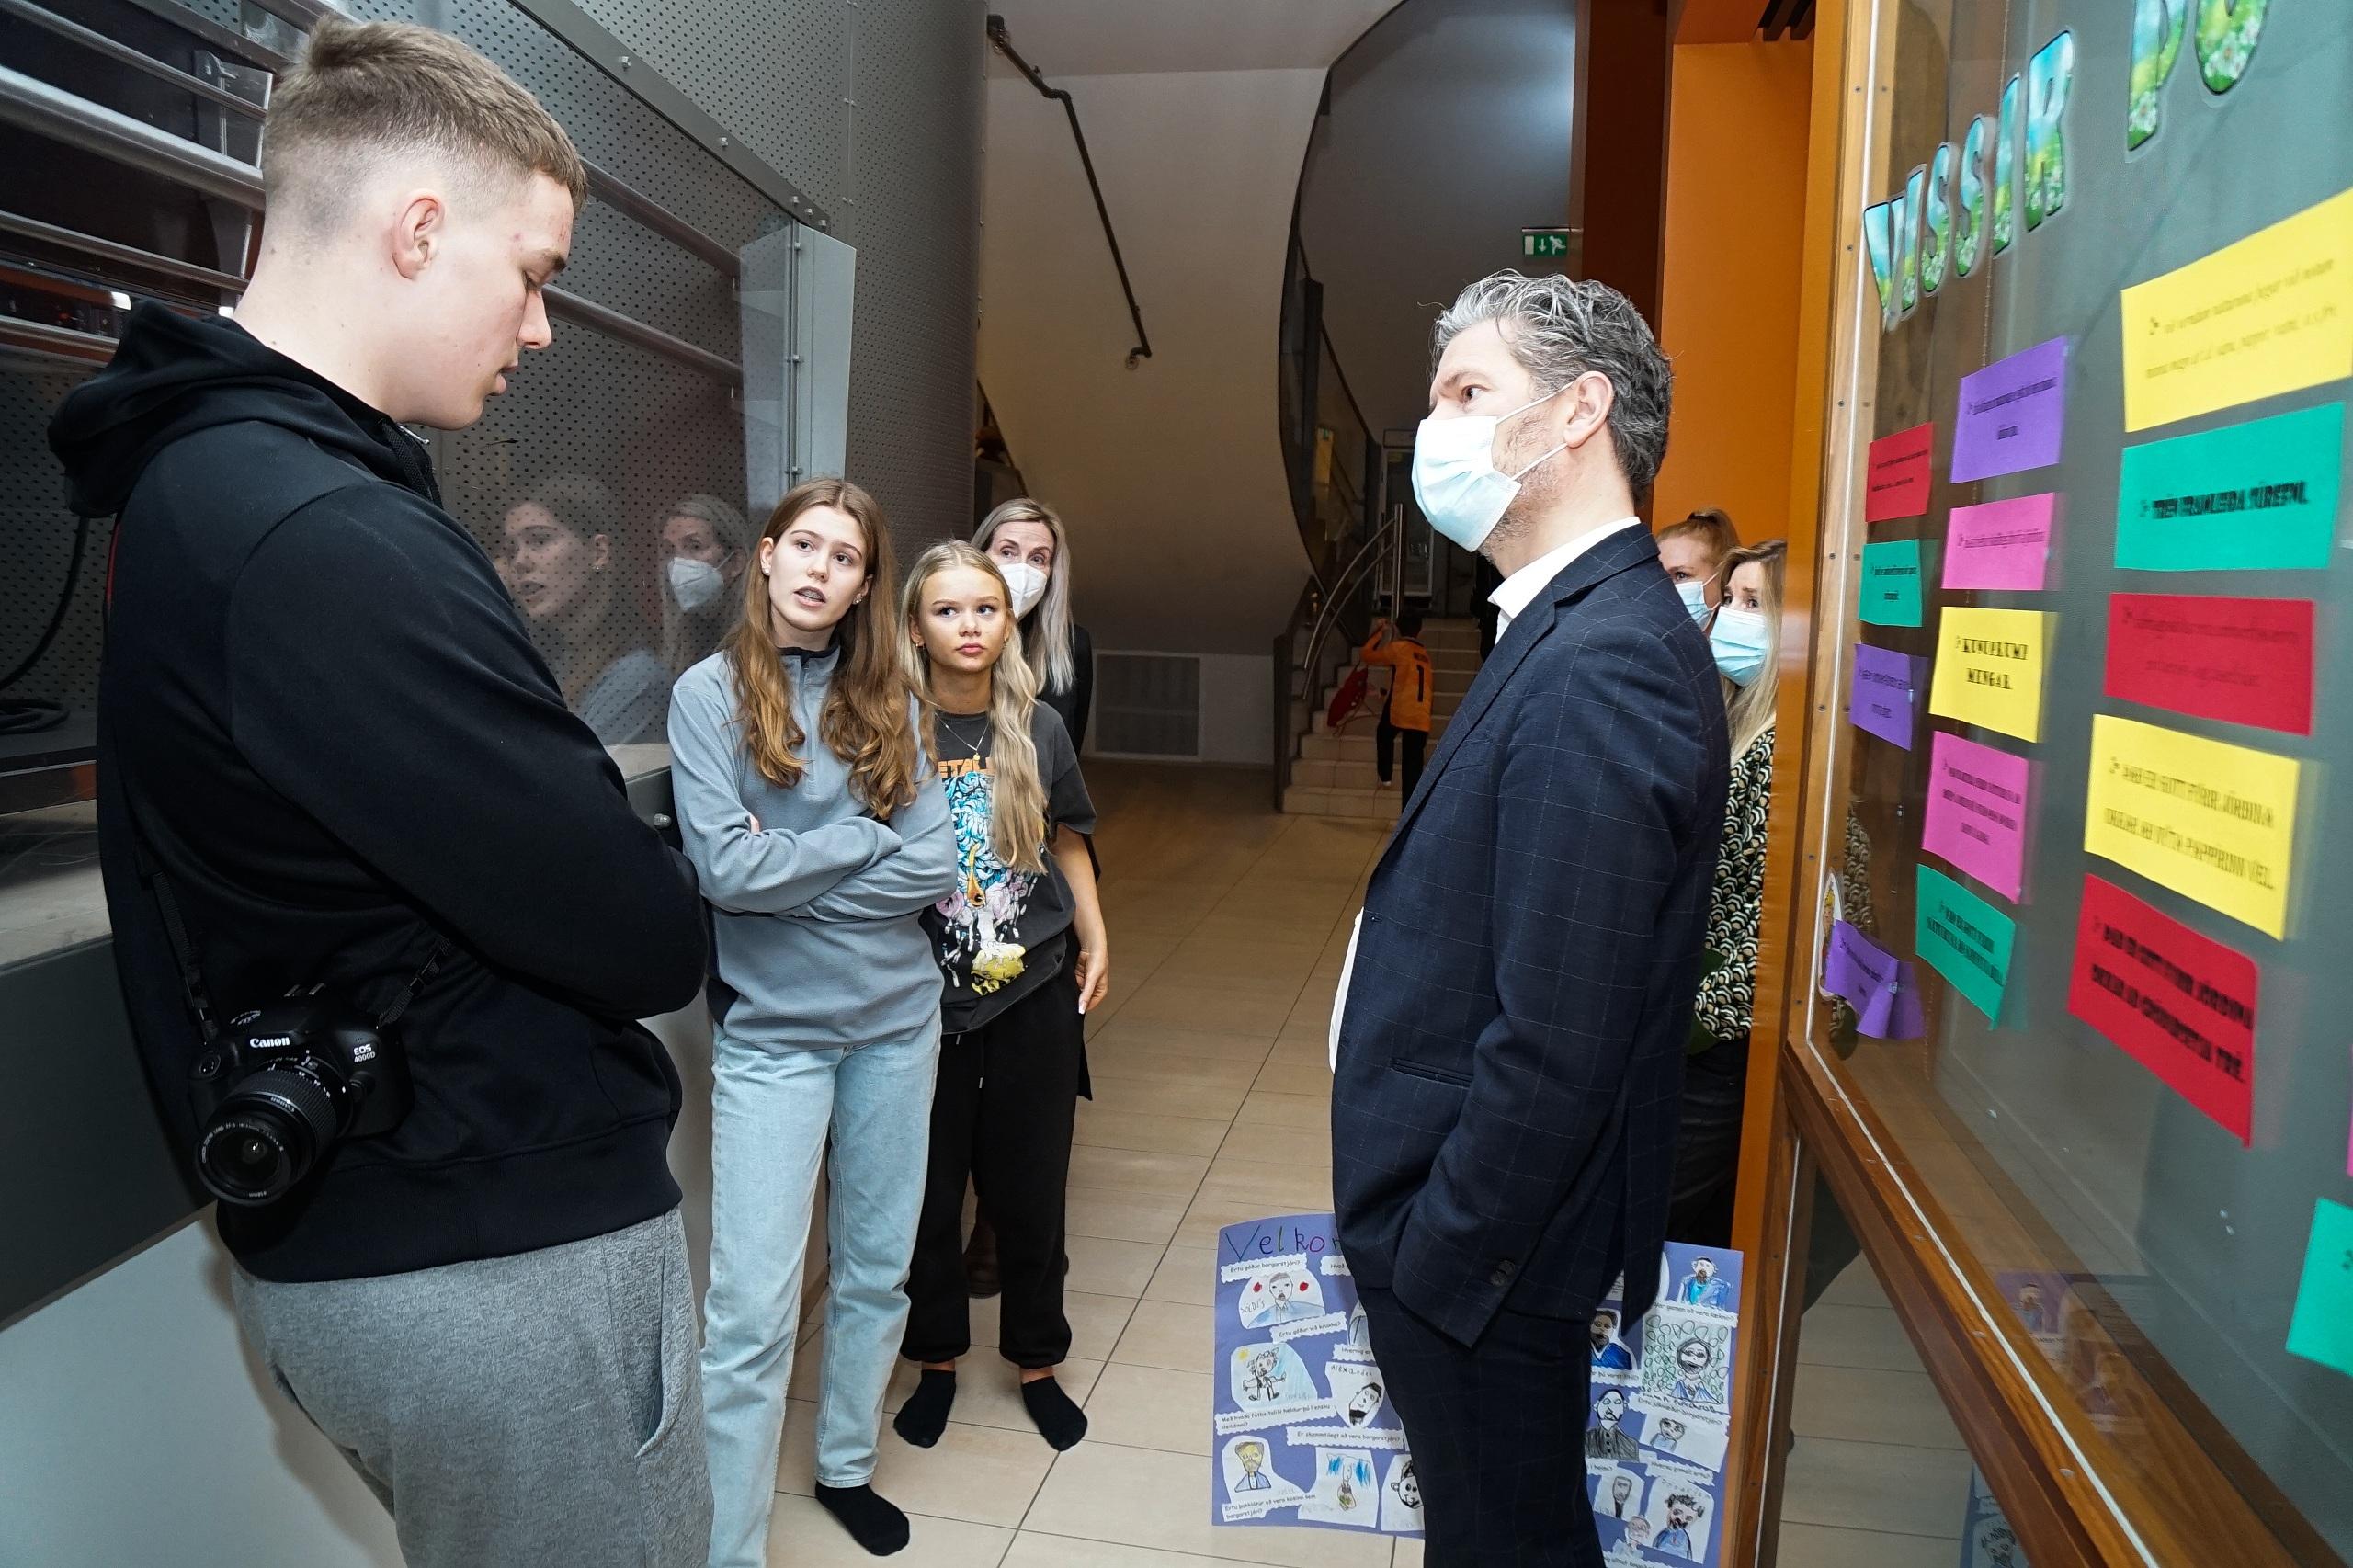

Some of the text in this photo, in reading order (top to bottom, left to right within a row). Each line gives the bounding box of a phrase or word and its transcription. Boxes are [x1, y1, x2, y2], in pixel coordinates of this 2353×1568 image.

[1864, 30, 2074, 313] VISSIR
[250, 1036, 290, 1048] Canon
[353, 1043, 372, 1055] EOS
